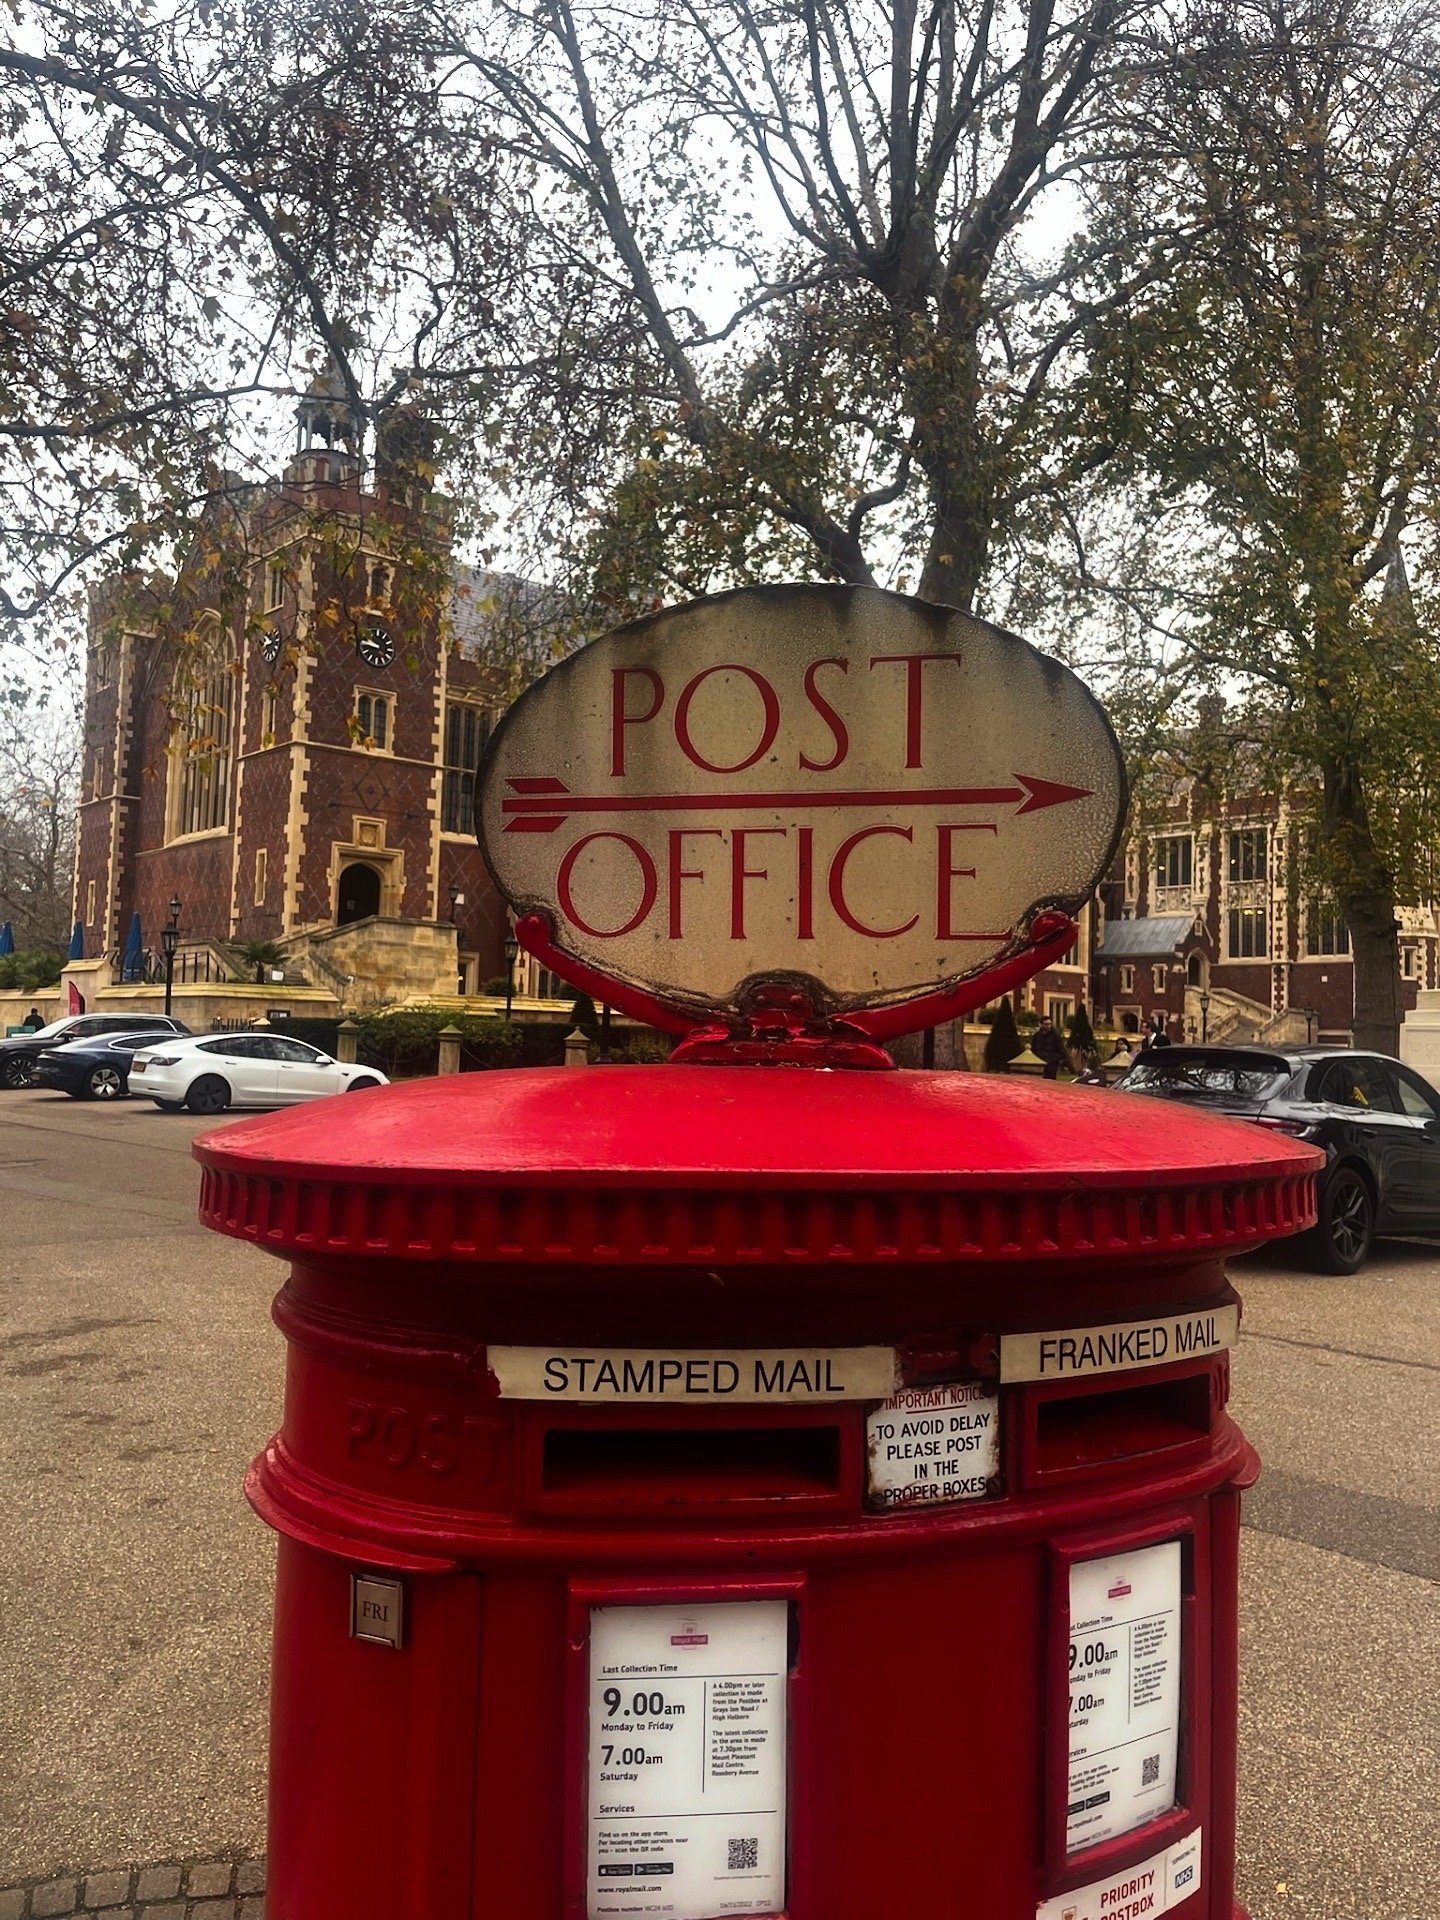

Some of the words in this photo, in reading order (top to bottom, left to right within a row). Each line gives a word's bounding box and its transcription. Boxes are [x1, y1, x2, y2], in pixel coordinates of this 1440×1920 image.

[610, 654, 962, 776] POST
[557, 823, 1013, 940] OFFICE
[1039, 1328, 1168, 1373] FRANKED
[1175, 1317, 1220, 1352] MAIL
[543, 1358, 741, 1393] STAMPED
[753, 1359, 845, 1393] MAIL
[885, 1390, 948, 1411] IMPORTANT
[876, 1424, 895, 1440] TO
[901, 1419, 944, 1438] AVOID
[951, 1413, 990, 1432] DELAY
[347, 1398, 512, 1484] POST
[887, 1441, 941, 1460] PLEASE
[947, 1435, 982, 1453] POST
[914, 1463, 928, 1479] IN
[934, 1459, 959, 1477] THE
[884, 1484, 938, 1503] PROPER
[944, 1476, 986, 1496] BOXES
[362, 1601, 389, 1622] FRI
[1077, 1618, 1100, 1630] Collection
[1100, 1616, 1113, 1624] Time
[1069, 1642, 1118, 1671] 9.00am
[621, 1665, 657, 1673] Collection
[660, 1664, 678, 1672] Time
[1070, 1671, 1086, 1684] onday
[1087, 1670, 1094, 1679] to
[1094, 1667, 1111, 1678] Friday
[603, 1687, 685, 1717] 9.00am
[601, 1723, 634, 1732] Monday
[637, 1723, 645, 1731] to
[648, 1722, 674, 1732] Friday
[1069, 1717, 1089, 1729] aturday
[601, 1745, 663, 1766] 7.00am
[1069, 1747, 1087, 1756] rvices
[600, 1772, 638, 1782] Saturday
[599, 1804, 635, 1814] Services
[1177, 1868, 1192, 1885] NHS
[598, 1885, 662, 1893] www.royalmail.com
[1100, 1869, 1155, 1908] PRIORITY
